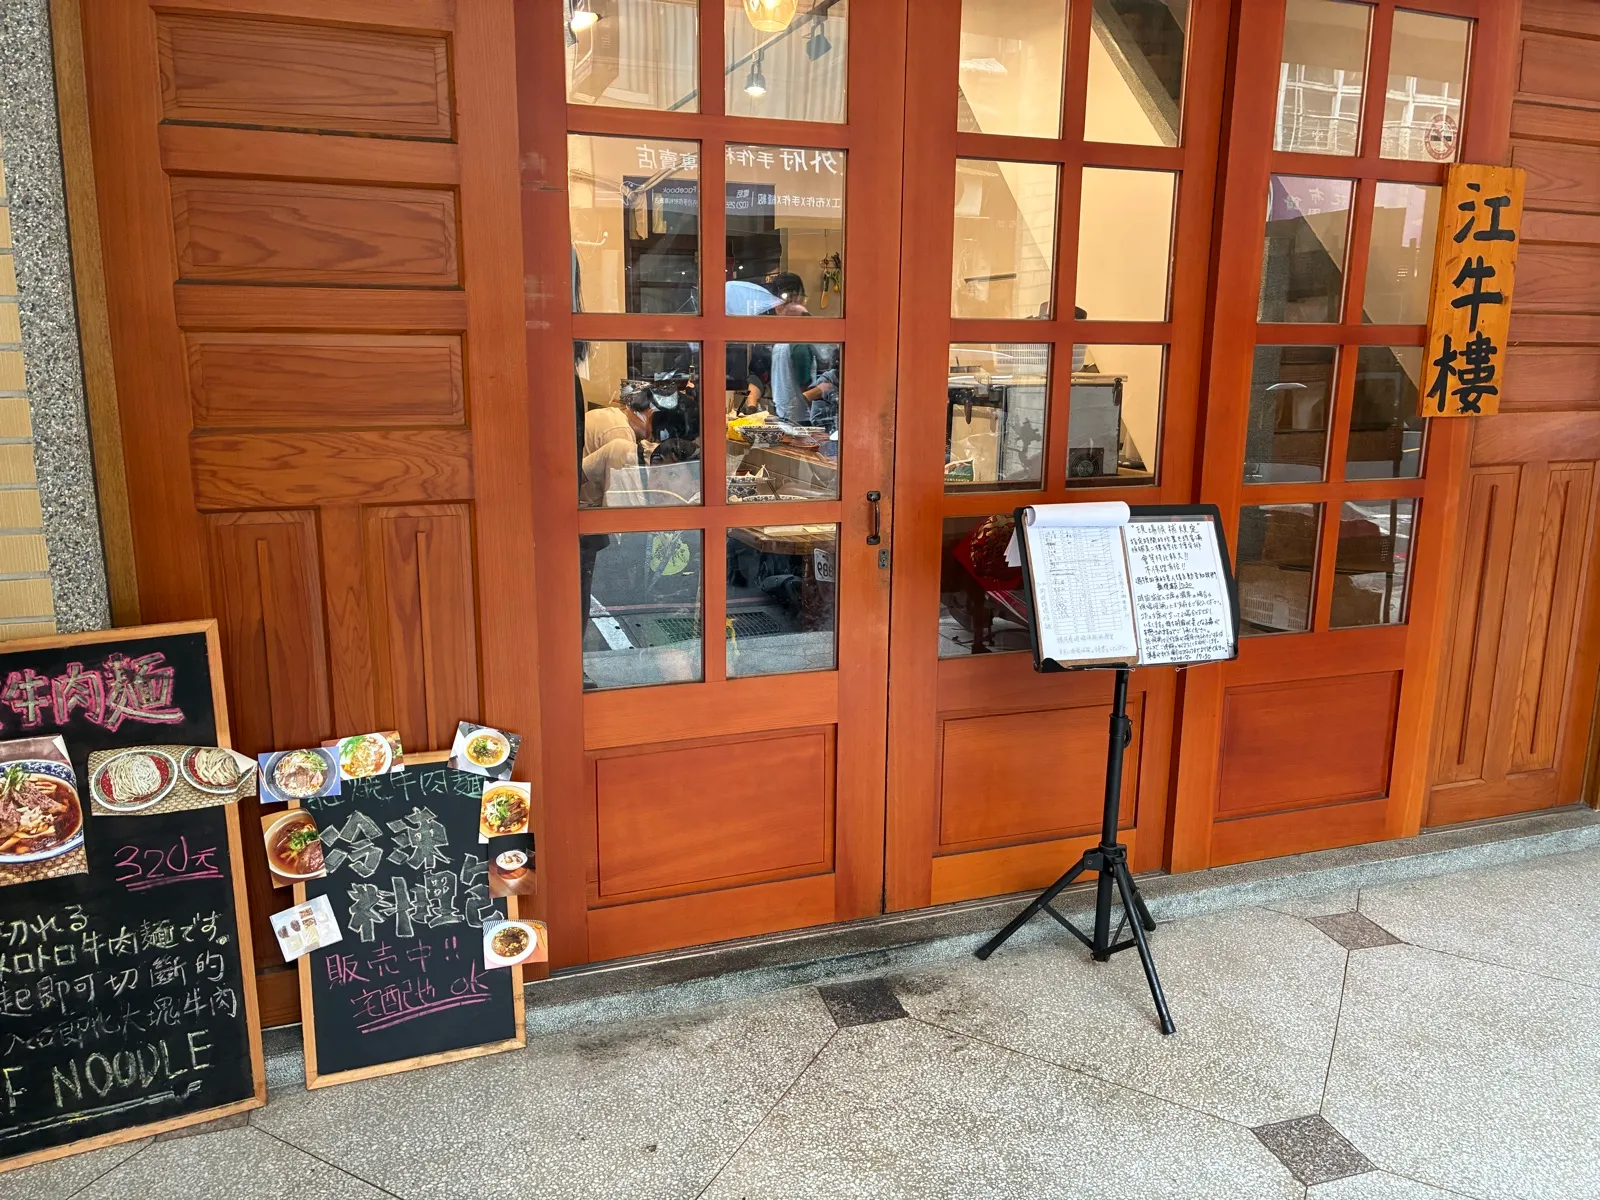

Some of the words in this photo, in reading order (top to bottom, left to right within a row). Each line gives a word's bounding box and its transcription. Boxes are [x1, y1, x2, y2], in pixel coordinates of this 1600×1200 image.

[1427, 183, 1515, 413] 江牛樓
[113, 836, 220, 882] 320元
[52, 1029, 215, 1109] NOODLE
